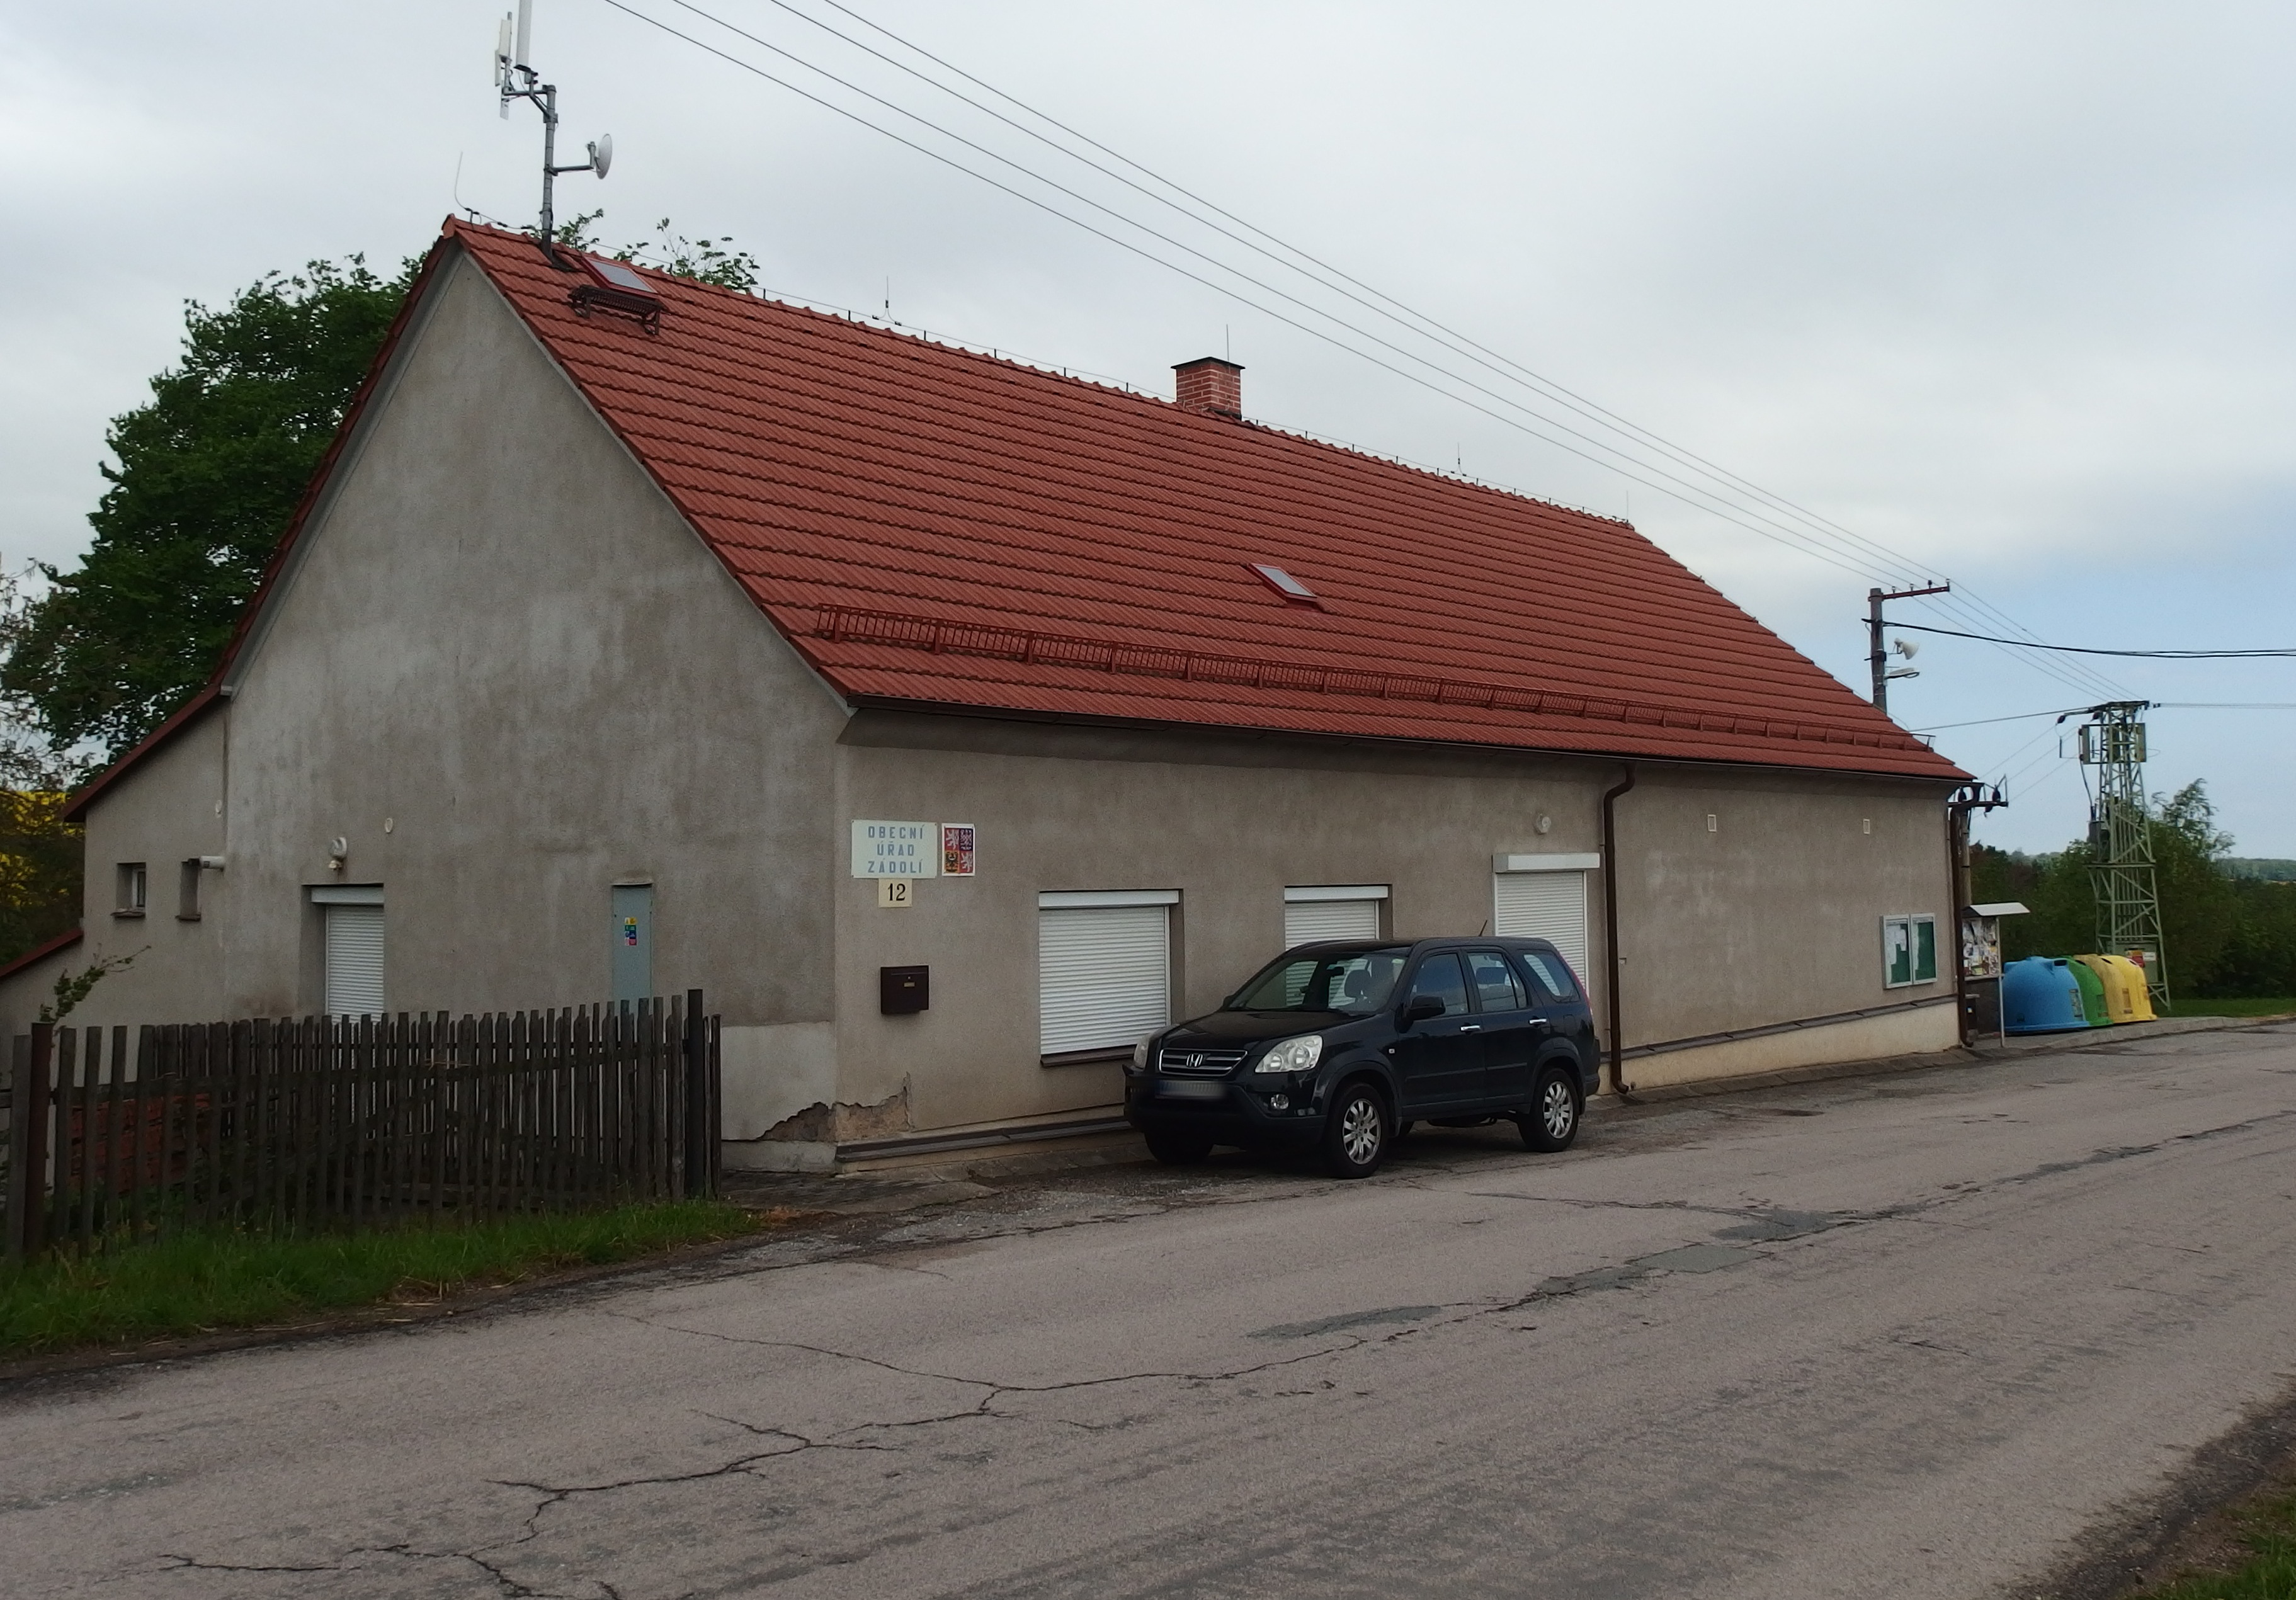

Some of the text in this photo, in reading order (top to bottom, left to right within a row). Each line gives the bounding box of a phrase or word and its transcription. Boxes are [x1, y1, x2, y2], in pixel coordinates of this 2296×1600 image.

[868, 824, 924, 839] OBECNÍ
[877, 841, 914, 856] ÚŘAD
[868, 858, 923, 873] ZÁDOLÍ
[887, 883, 906, 901] 12
